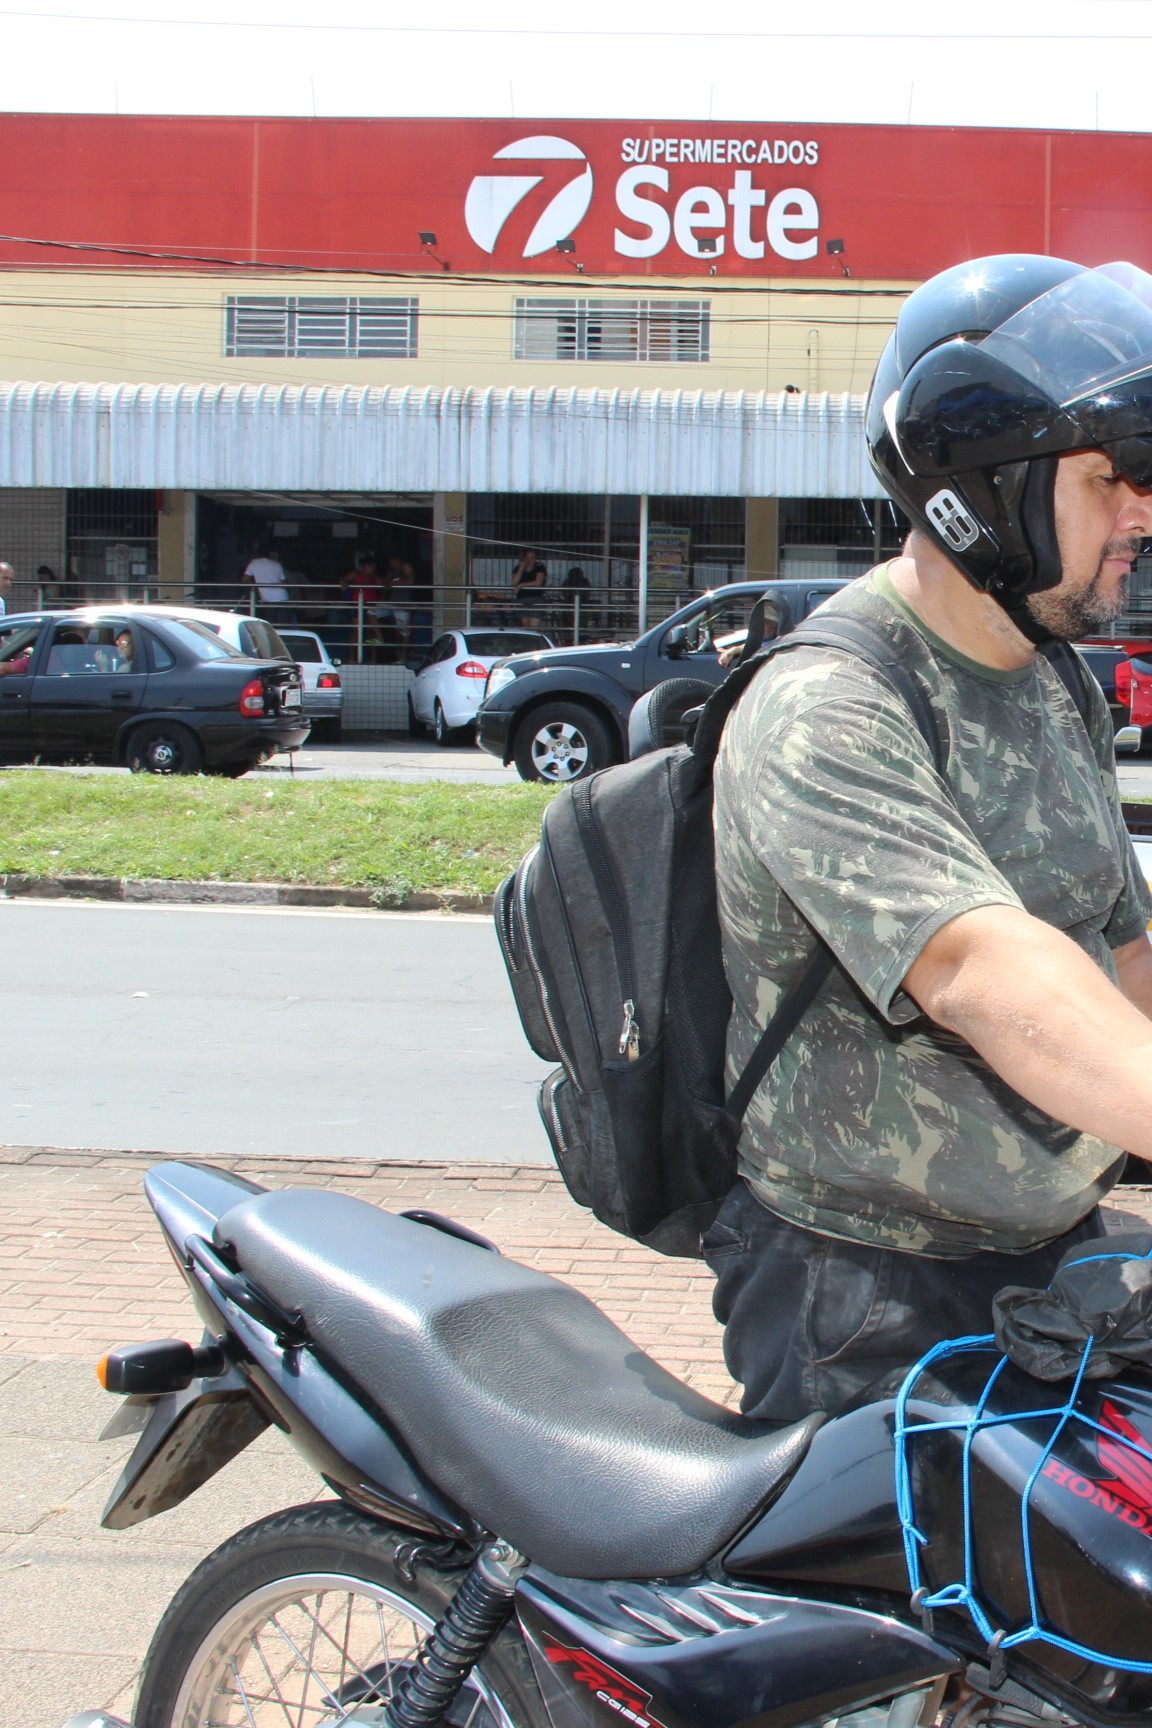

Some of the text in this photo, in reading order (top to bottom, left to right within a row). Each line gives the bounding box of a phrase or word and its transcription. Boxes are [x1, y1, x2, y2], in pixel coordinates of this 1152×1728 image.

[621, 138, 819, 166] SUPERMERCADOS
[614, 165, 820, 260] Sete
[596, 1690, 651, 1728] CG125
